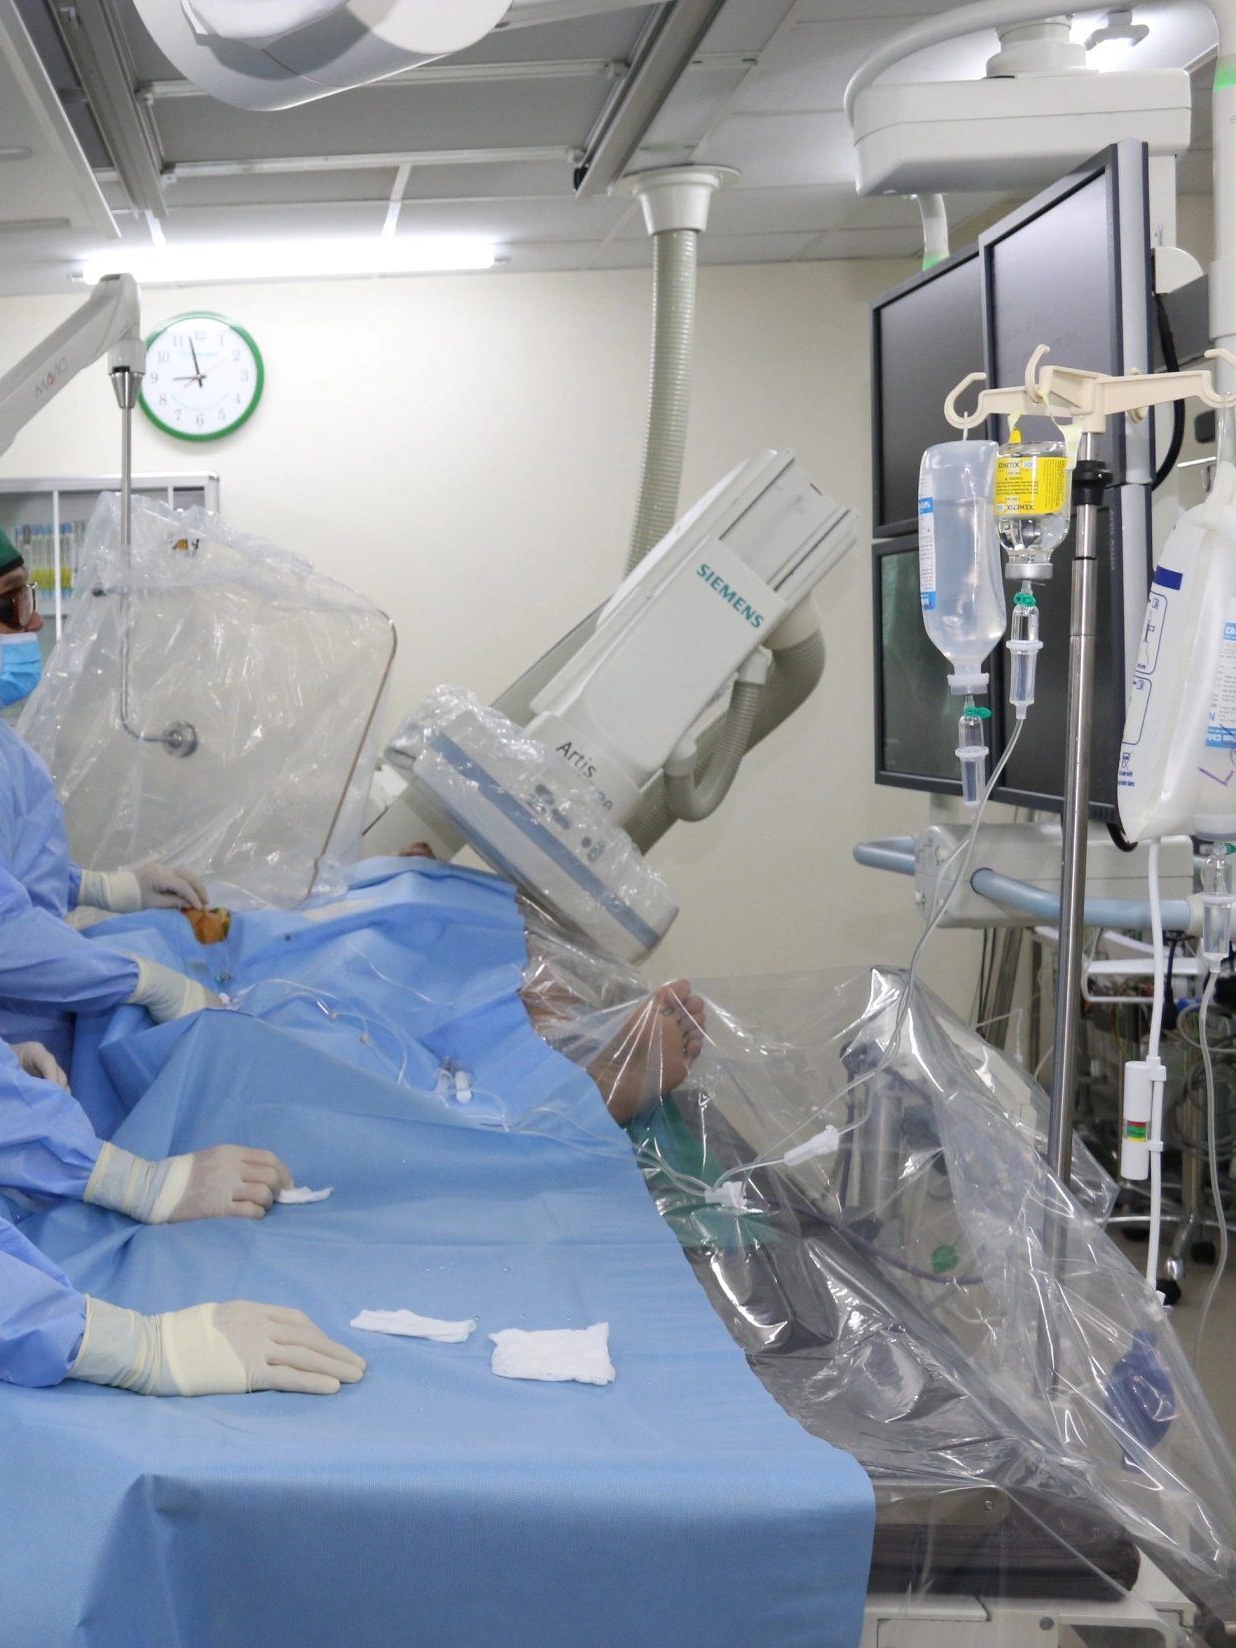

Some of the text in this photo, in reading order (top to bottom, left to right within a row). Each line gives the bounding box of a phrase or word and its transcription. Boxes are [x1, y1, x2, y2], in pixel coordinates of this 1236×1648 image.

[173, 334, 184, 347] 11
[195, 330, 206, 340] 12
[219, 334, 224, 346] 1
[157, 351, 169, 363] 10
[233, 350, 240, 361] 2
[150, 372, 158, 384] 9
[241, 369, 249, 382] 3
[159, 394, 167, 405] 8
[234, 392, 241, 404] 4
[174, 409, 182, 421] 7
[196, 414, 204, 426] 6
[219, 409, 225, 420] 5
[696, 563, 765, 629] SIEMENS
[555, 740, 597, 779] Artis
